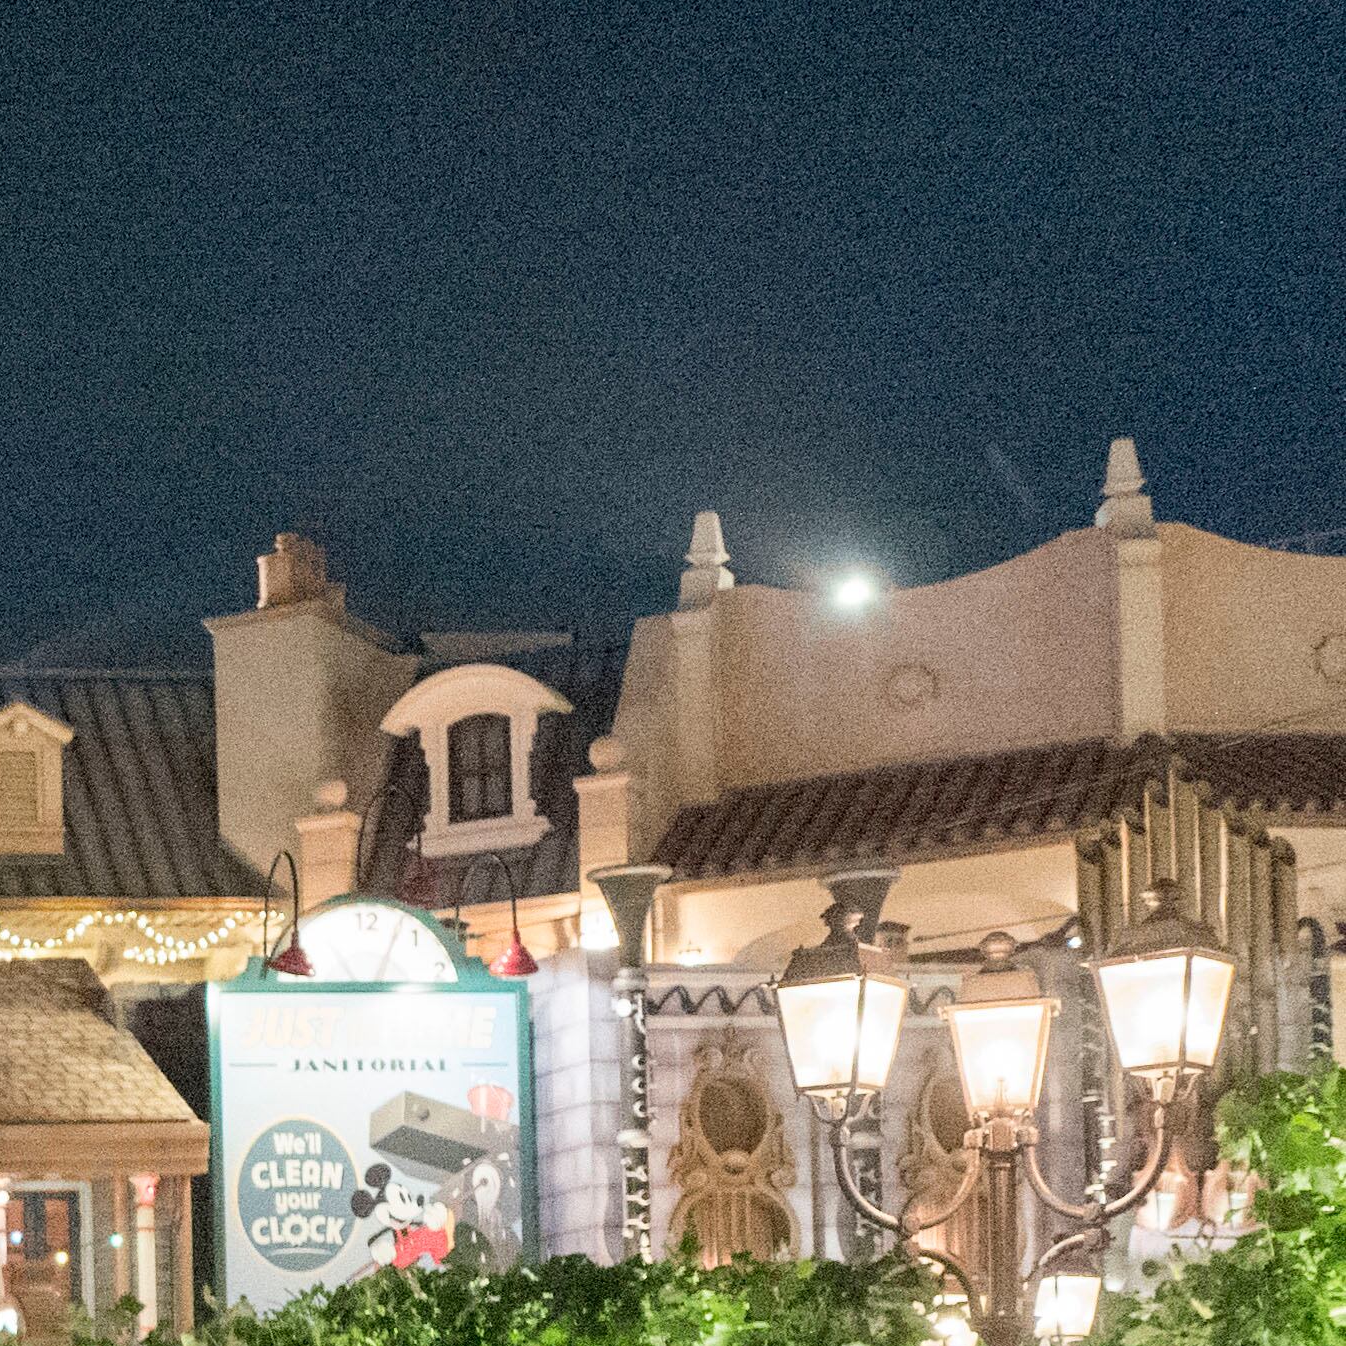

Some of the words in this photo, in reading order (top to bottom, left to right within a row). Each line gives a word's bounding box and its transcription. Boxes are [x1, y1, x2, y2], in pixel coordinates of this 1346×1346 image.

[289, 1057, 449, 1073] JANITORIAL
[251, 1159, 344, 1190] CLEAN
[274, 1191, 321, 1214] your
[251, 1214, 345, 1247] CLOCK
